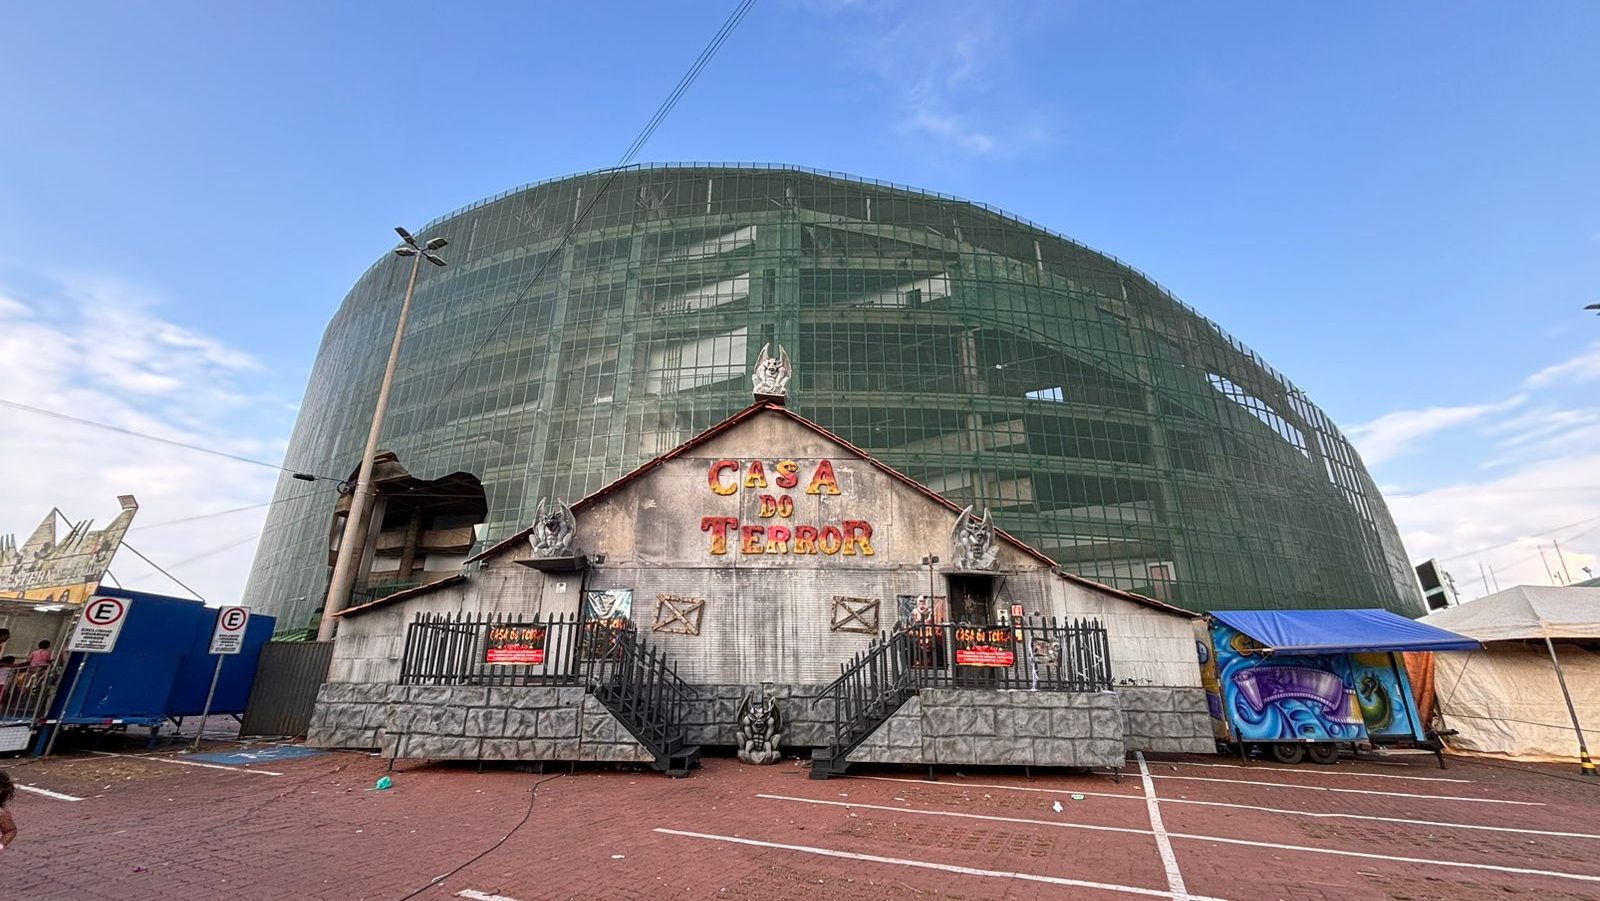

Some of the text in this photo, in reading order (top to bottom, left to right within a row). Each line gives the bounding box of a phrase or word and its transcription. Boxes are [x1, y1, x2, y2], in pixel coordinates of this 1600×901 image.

[708, 459, 841, 496] CASA
[758, 494, 794, 518] DO
[701, 516, 875, 556] TERROR
[94, 603, 114, 620] E
[227, 612, 241, 626] E
